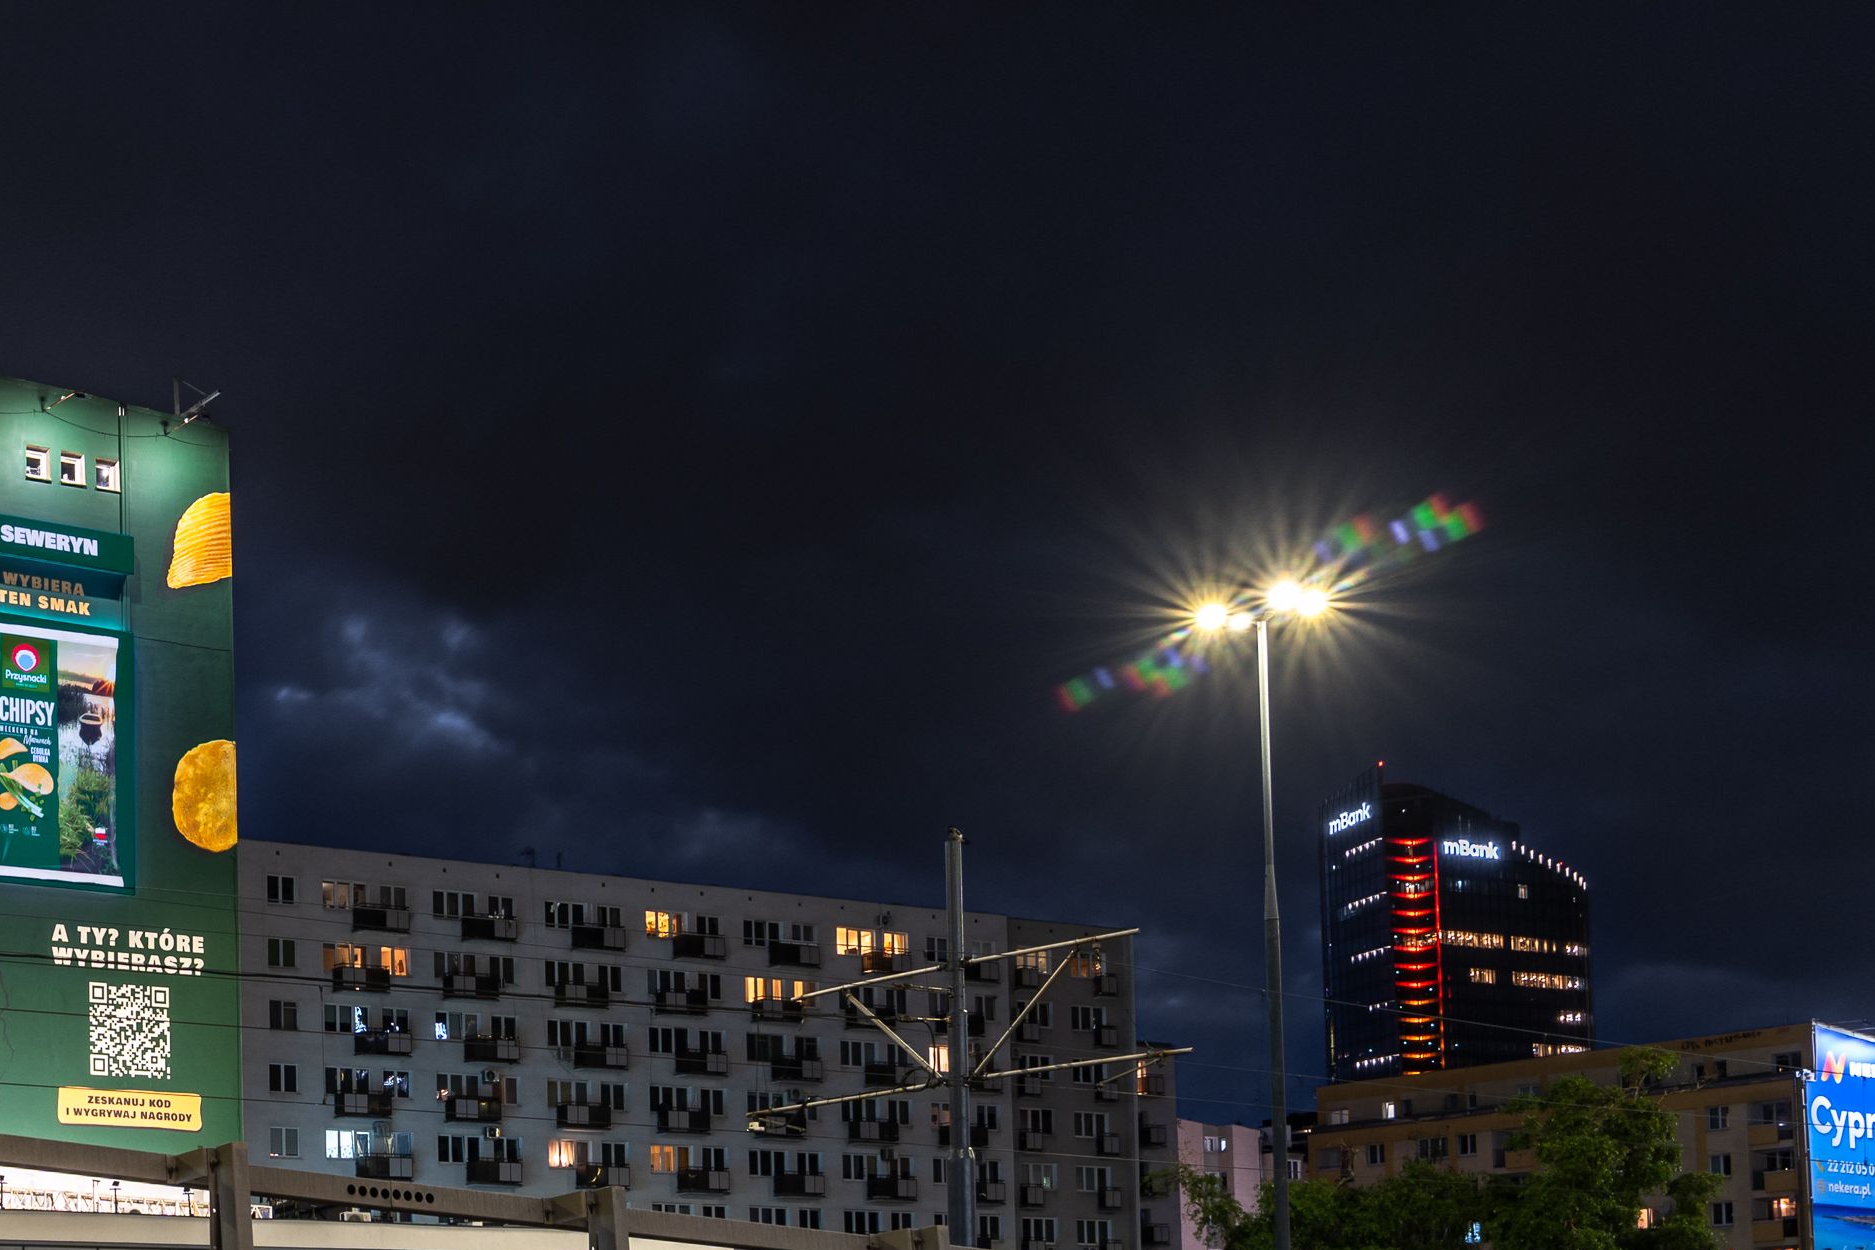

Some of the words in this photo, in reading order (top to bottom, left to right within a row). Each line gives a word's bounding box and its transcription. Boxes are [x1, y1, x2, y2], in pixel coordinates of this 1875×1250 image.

[0, 524, 99, 557] SEWERYN
[2, 571, 85, 597] WYBIERA
[38, 595, 91, 617] SMAK
[5, 668, 47, 684] Przysnacki
[0, 724, 28, 735] WEEKEND
[1329, 802, 1372, 835] mBank
[1443, 839, 1500, 860] mBank
[51, 923, 69, 943] A
[77, 925, 119, 947] TY?
[128, 928, 205, 954] KTÓRE
[51, 946, 205, 976] WYBIERASZ?
[87, 1095, 145, 1107] ZESKANUJ
[149, 1099, 171, 1109] KOD
[73, 1107, 137, 1119] WYGRYWAJ
[140, 1111, 193, 1123] NAGRODY
[1827, 1159, 1839, 1173] 22
[1840, 1160, 1855, 1174] 212
[1828, 1180, 1872, 1199] nekera.pl
